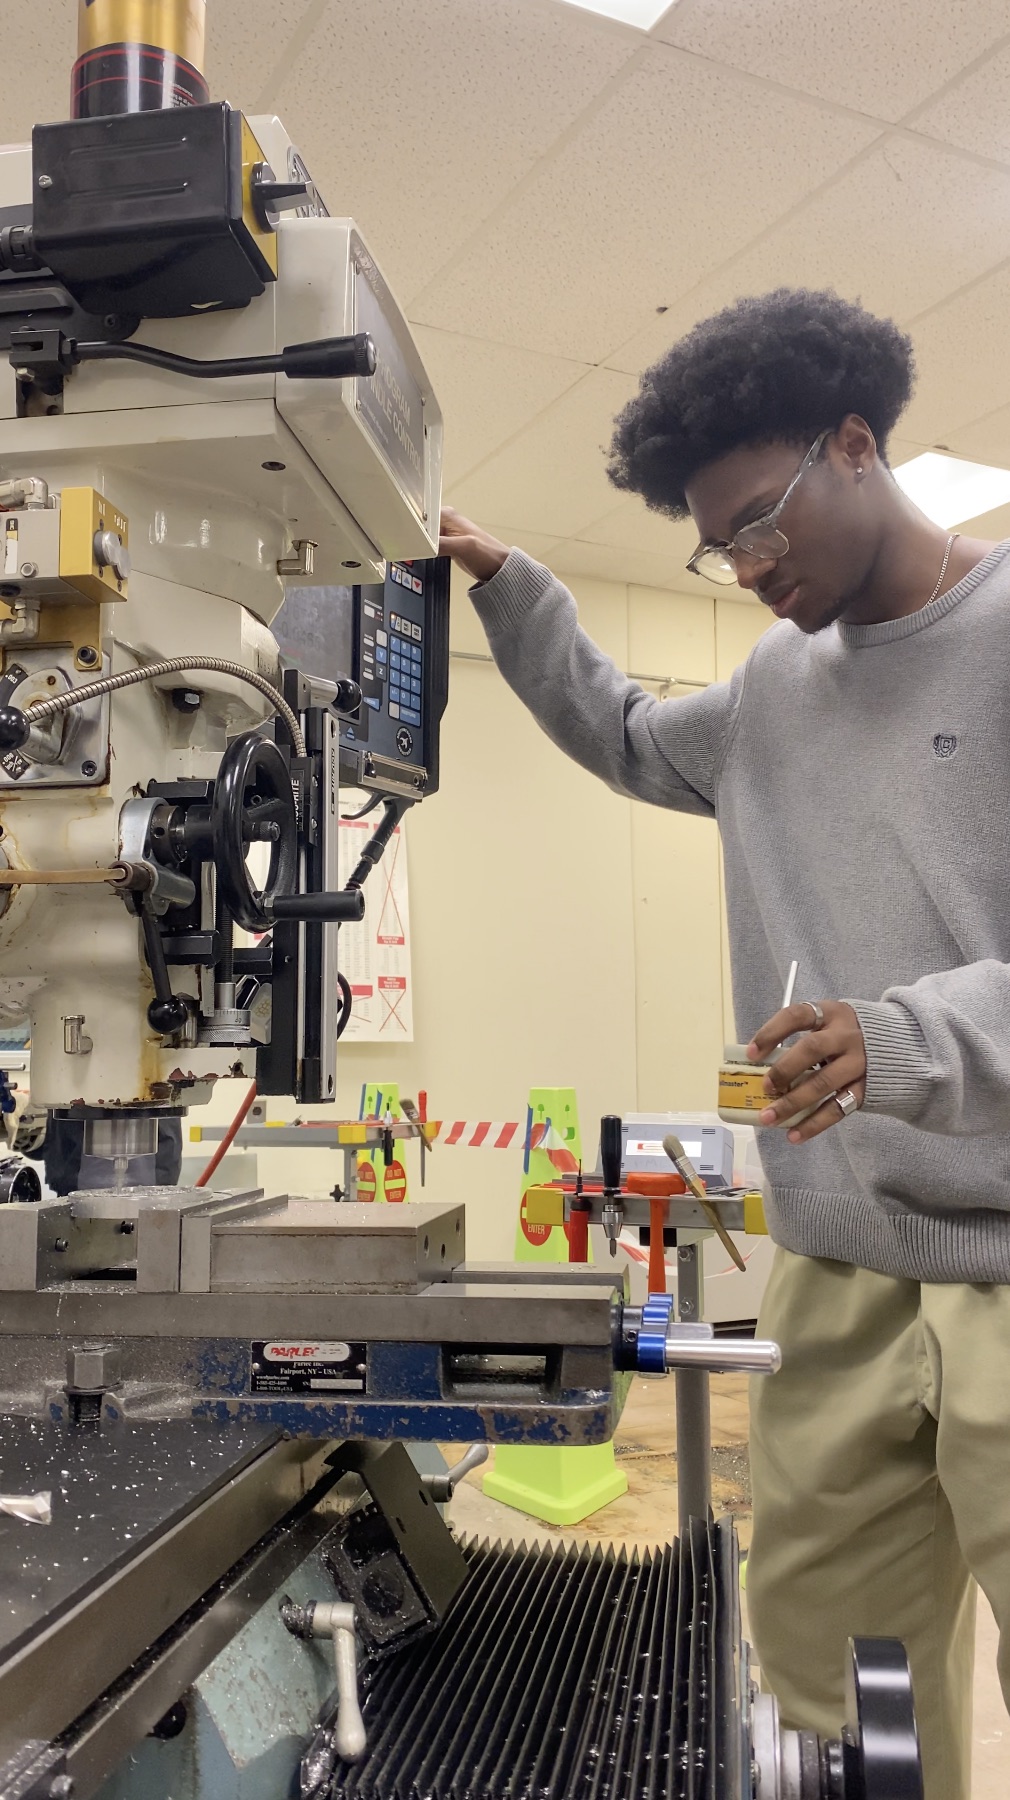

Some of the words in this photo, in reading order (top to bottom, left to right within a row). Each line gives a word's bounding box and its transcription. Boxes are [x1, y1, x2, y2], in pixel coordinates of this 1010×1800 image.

[393, 411, 423, 479] CONTROL
[527, 1224, 546, 1236] ENTER
[280, 1368, 307, 1376] Fairport,
